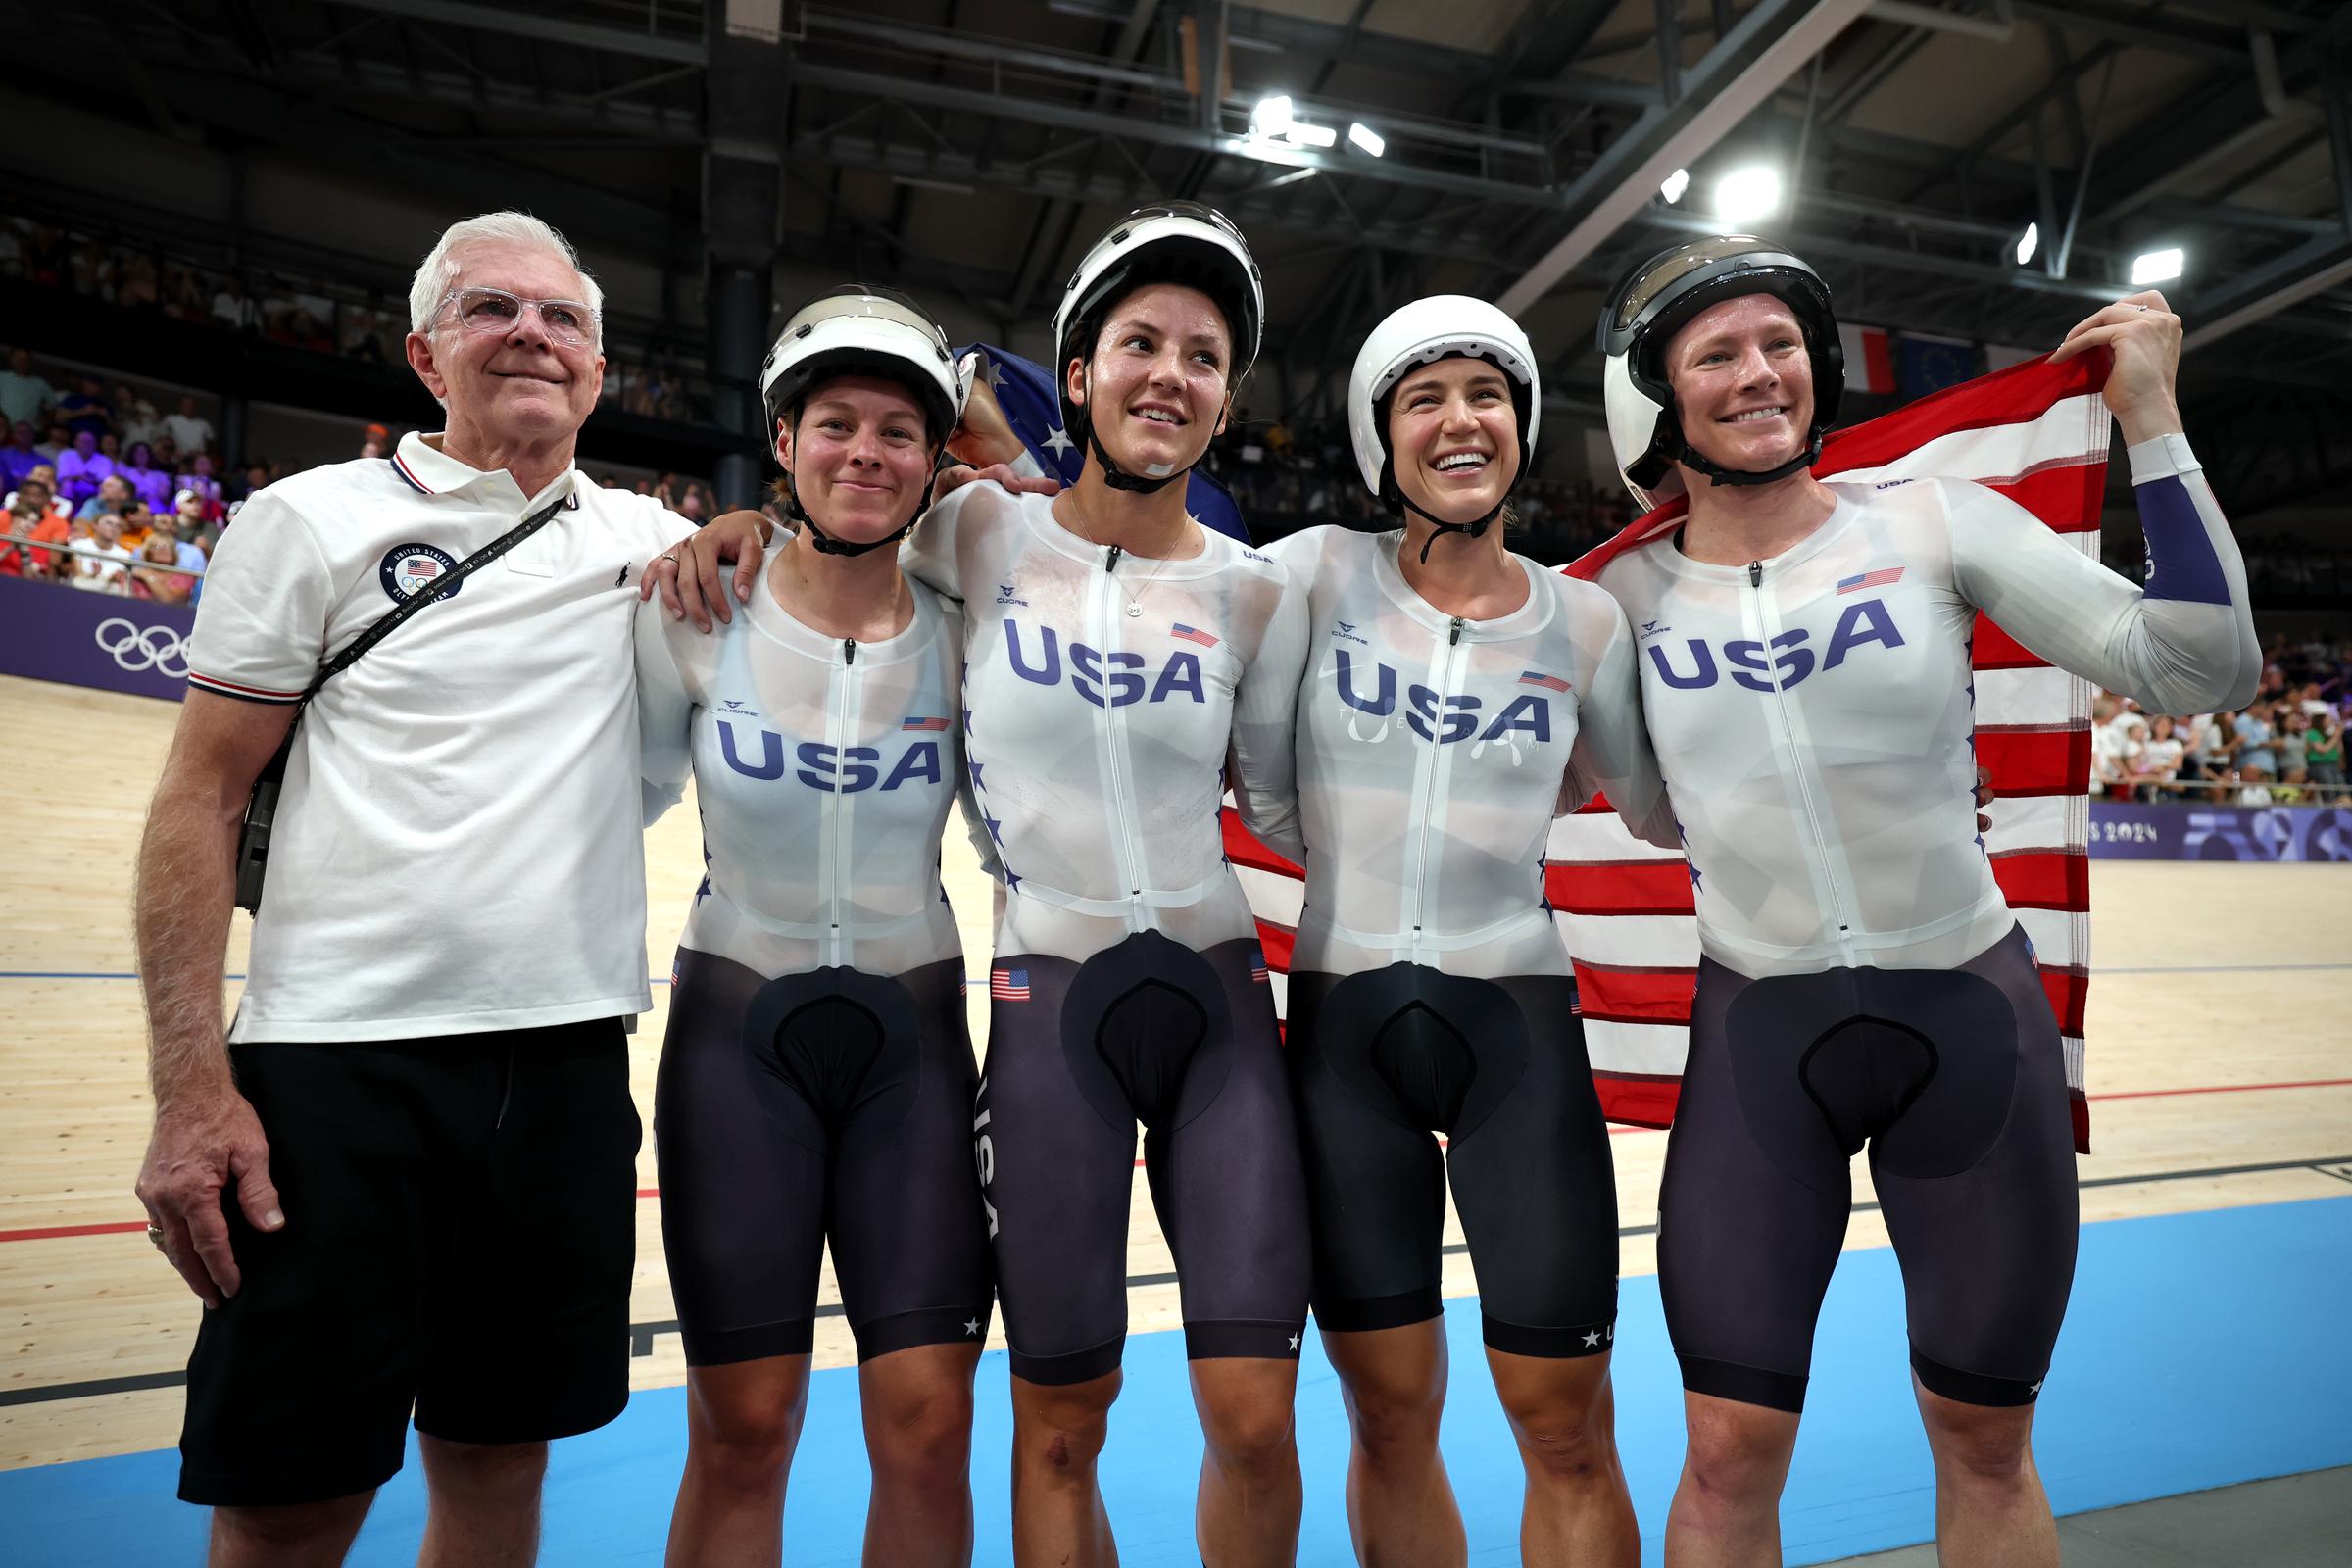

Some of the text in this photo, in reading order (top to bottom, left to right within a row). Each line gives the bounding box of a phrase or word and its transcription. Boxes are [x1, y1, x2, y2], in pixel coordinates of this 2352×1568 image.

[1876, 478, 1915, 489] USA
[394, 548, 450, 566] UNITED STATES
[1243, 550, 1275, 564] USA
[996, 598, 1029, 608] CUORE
[1331, 630, 1369, 646] CUORE
[1641, 626, 1672, 640] CUORE
[1648, 599, 1906, 693] USA
[1004, 619, 1205, 709] USA
[1335, 649, 1551, 745] USA
[717, 708, 760, 717] CUORE
[716, 720, 942, 794] USA
[2103, 822, 2158, 843] 2024
